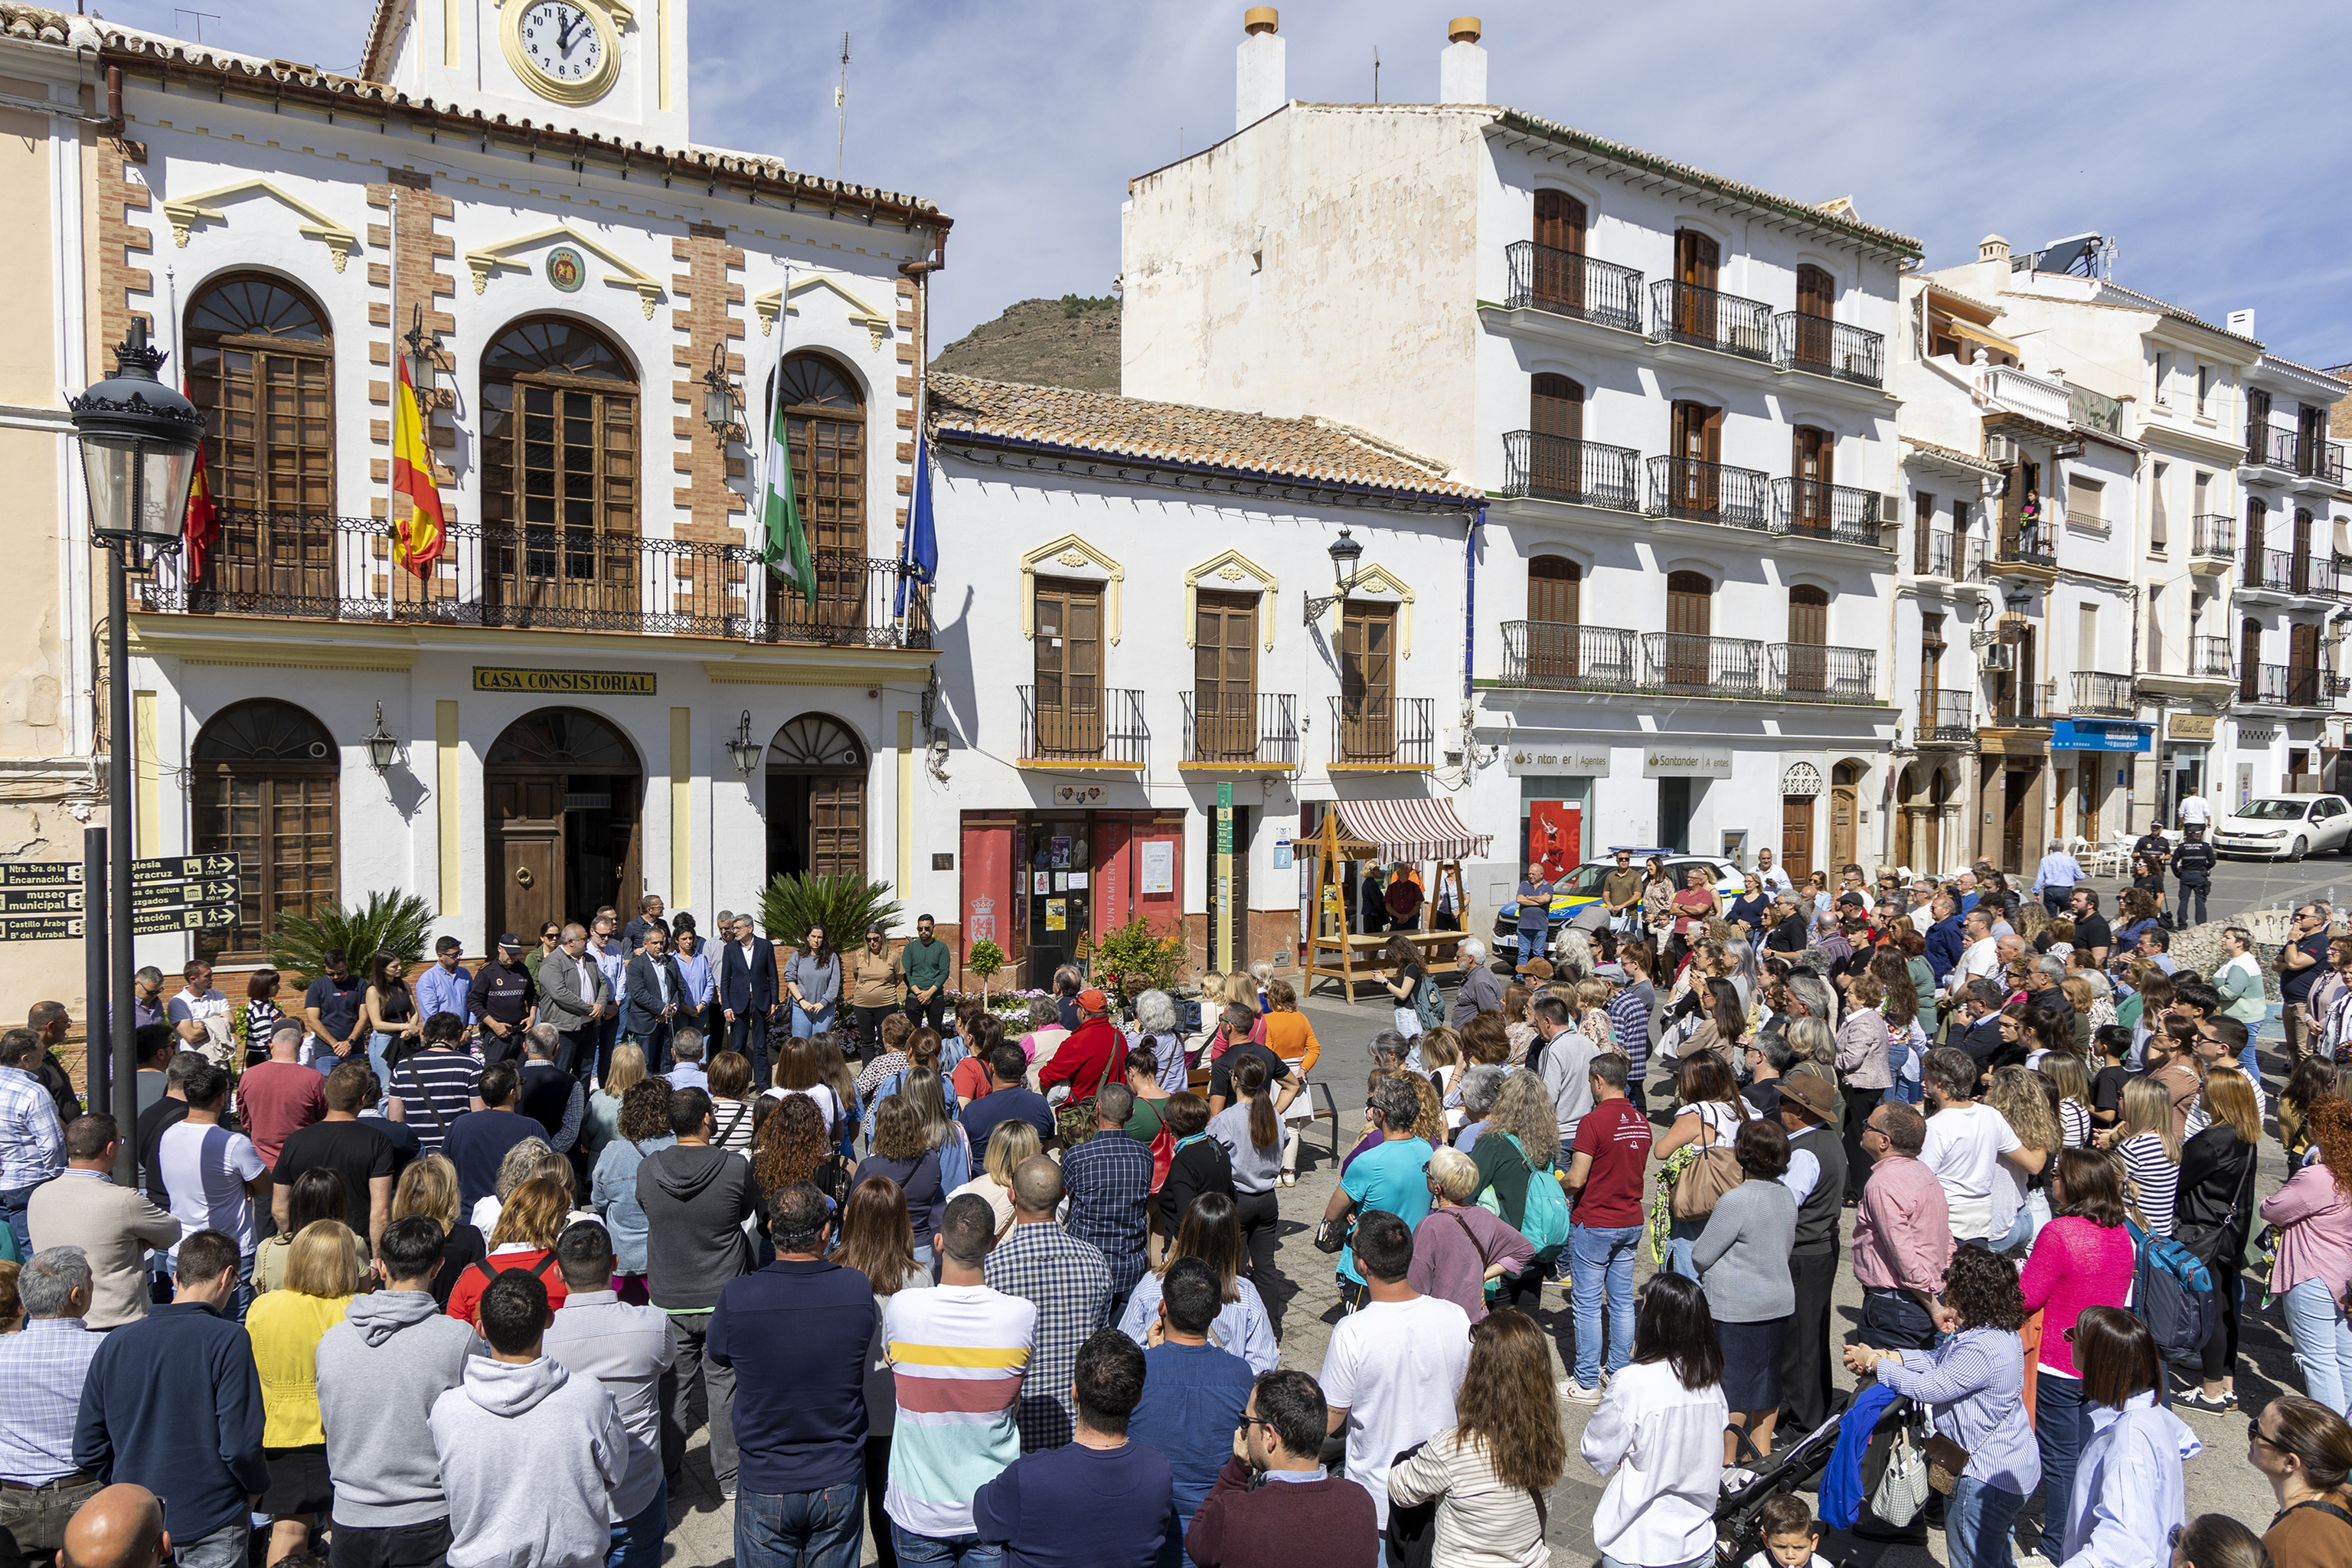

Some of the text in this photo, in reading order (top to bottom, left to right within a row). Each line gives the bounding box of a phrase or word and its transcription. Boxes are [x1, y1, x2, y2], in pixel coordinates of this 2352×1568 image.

[544, 8, 552, 18] 11
[533, 15, 543, 26] 10
[527, 28, 534, 38] 9
[585, 28, 591, 38] 2
[531, 44, 538, 54] 8
[590, 43, 596, 53] 3
[544, 57, 550, 67] 7
[585, 57, 591, 67] 4
[559, 65, 565, 75] 6
[573, 64, 580, 74] 5
[480, 672, 651, 691] CASA CONSISTORIAL
[1527, 753, 1606, 767] Santander Agentes
[1660, 756, 1729, 769] Santander Agentes
[132, 861, 162, 871] glesia
[9, 875, 65, 884] Encarnación
[132, 871, 173, 880] eracruz
[1106, 854, 1116, 934] AYUNTAMIENTO
[9, 900, 65, 910] municipal
[133, 897, 169, 906] uzgados
[43, 919, 66, 927] Árabe
[133, 913, 171, 923] stación
[133, 922, 181, 933] errocarril
